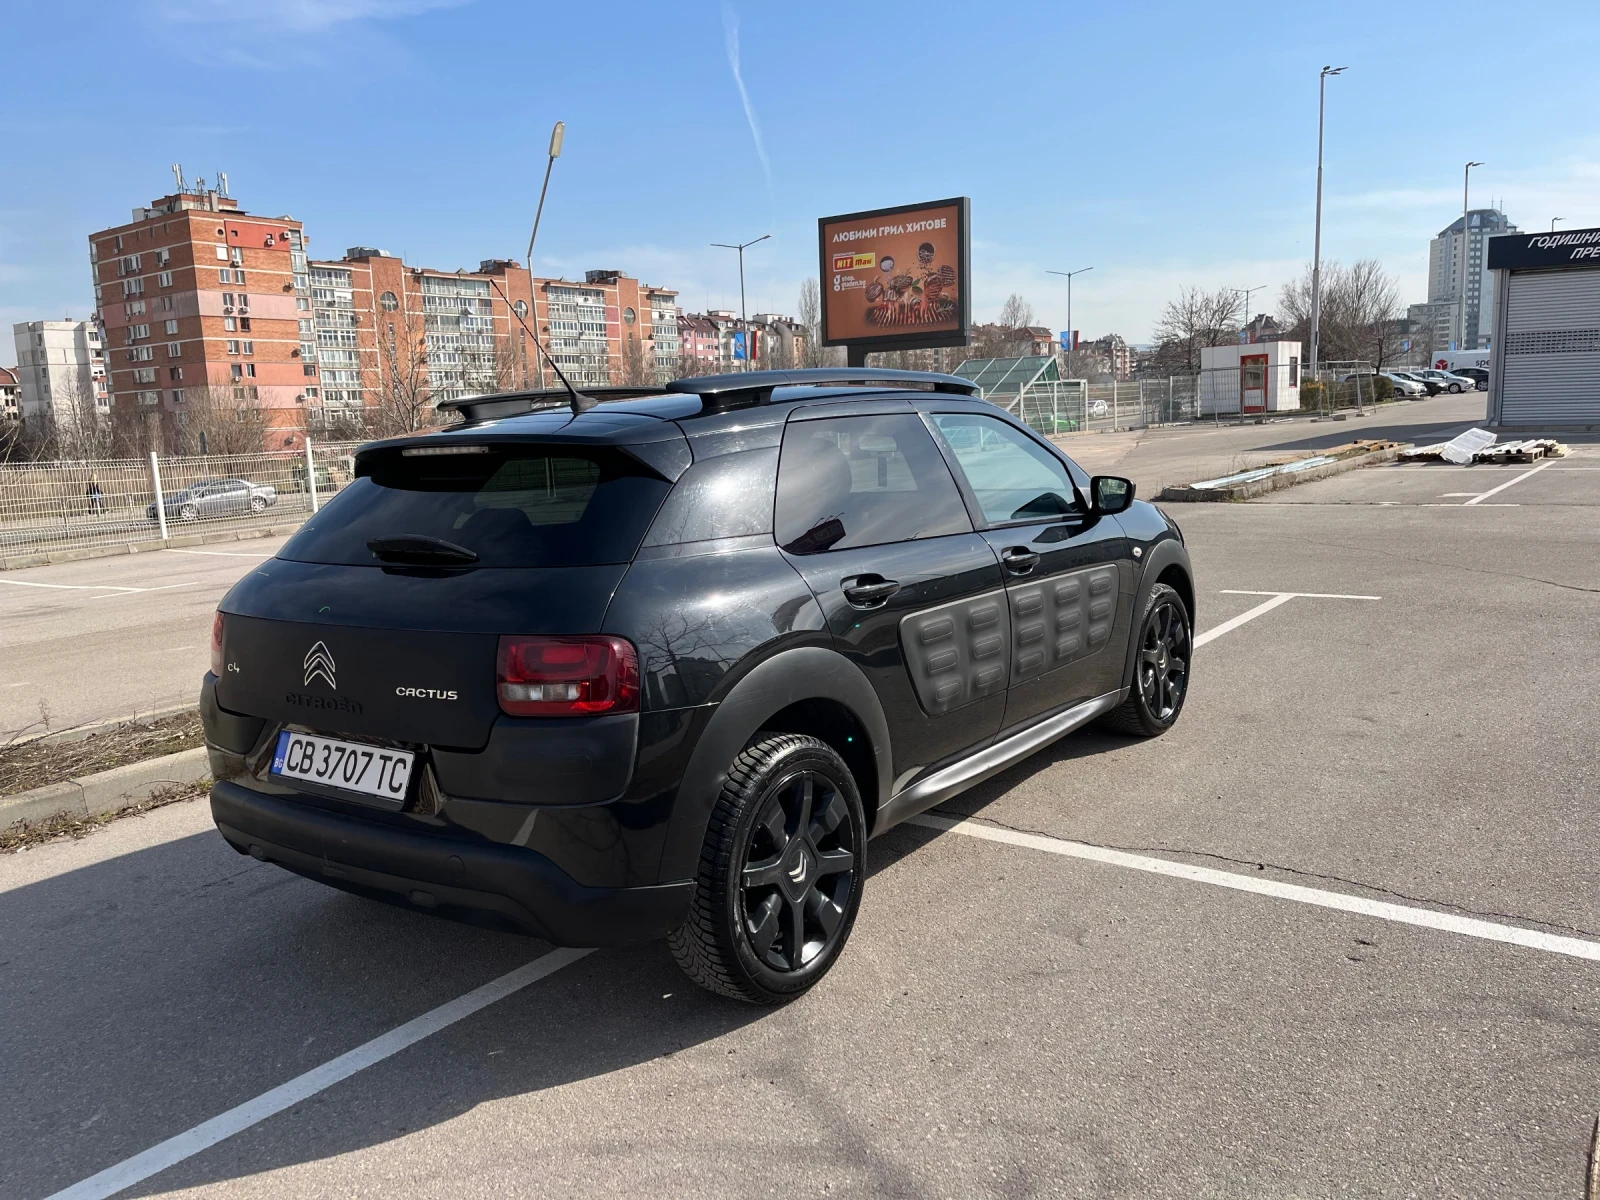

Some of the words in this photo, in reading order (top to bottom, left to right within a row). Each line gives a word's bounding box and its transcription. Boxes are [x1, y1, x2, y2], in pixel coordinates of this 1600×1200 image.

[832, 228, 876, 242] ЛЮБИМИ
[879, 224, 905, 237] ГРИЛ
[906, 218, 947, 233] ХИТОВЕ
[836, 259, 851, 268] HIT
[227, 662, 240, 673] C4
[395, 686, 458, 700] CACTUS
[286, 692, 363, 715] CITROËN
[273, 757, 283, 769] BG
